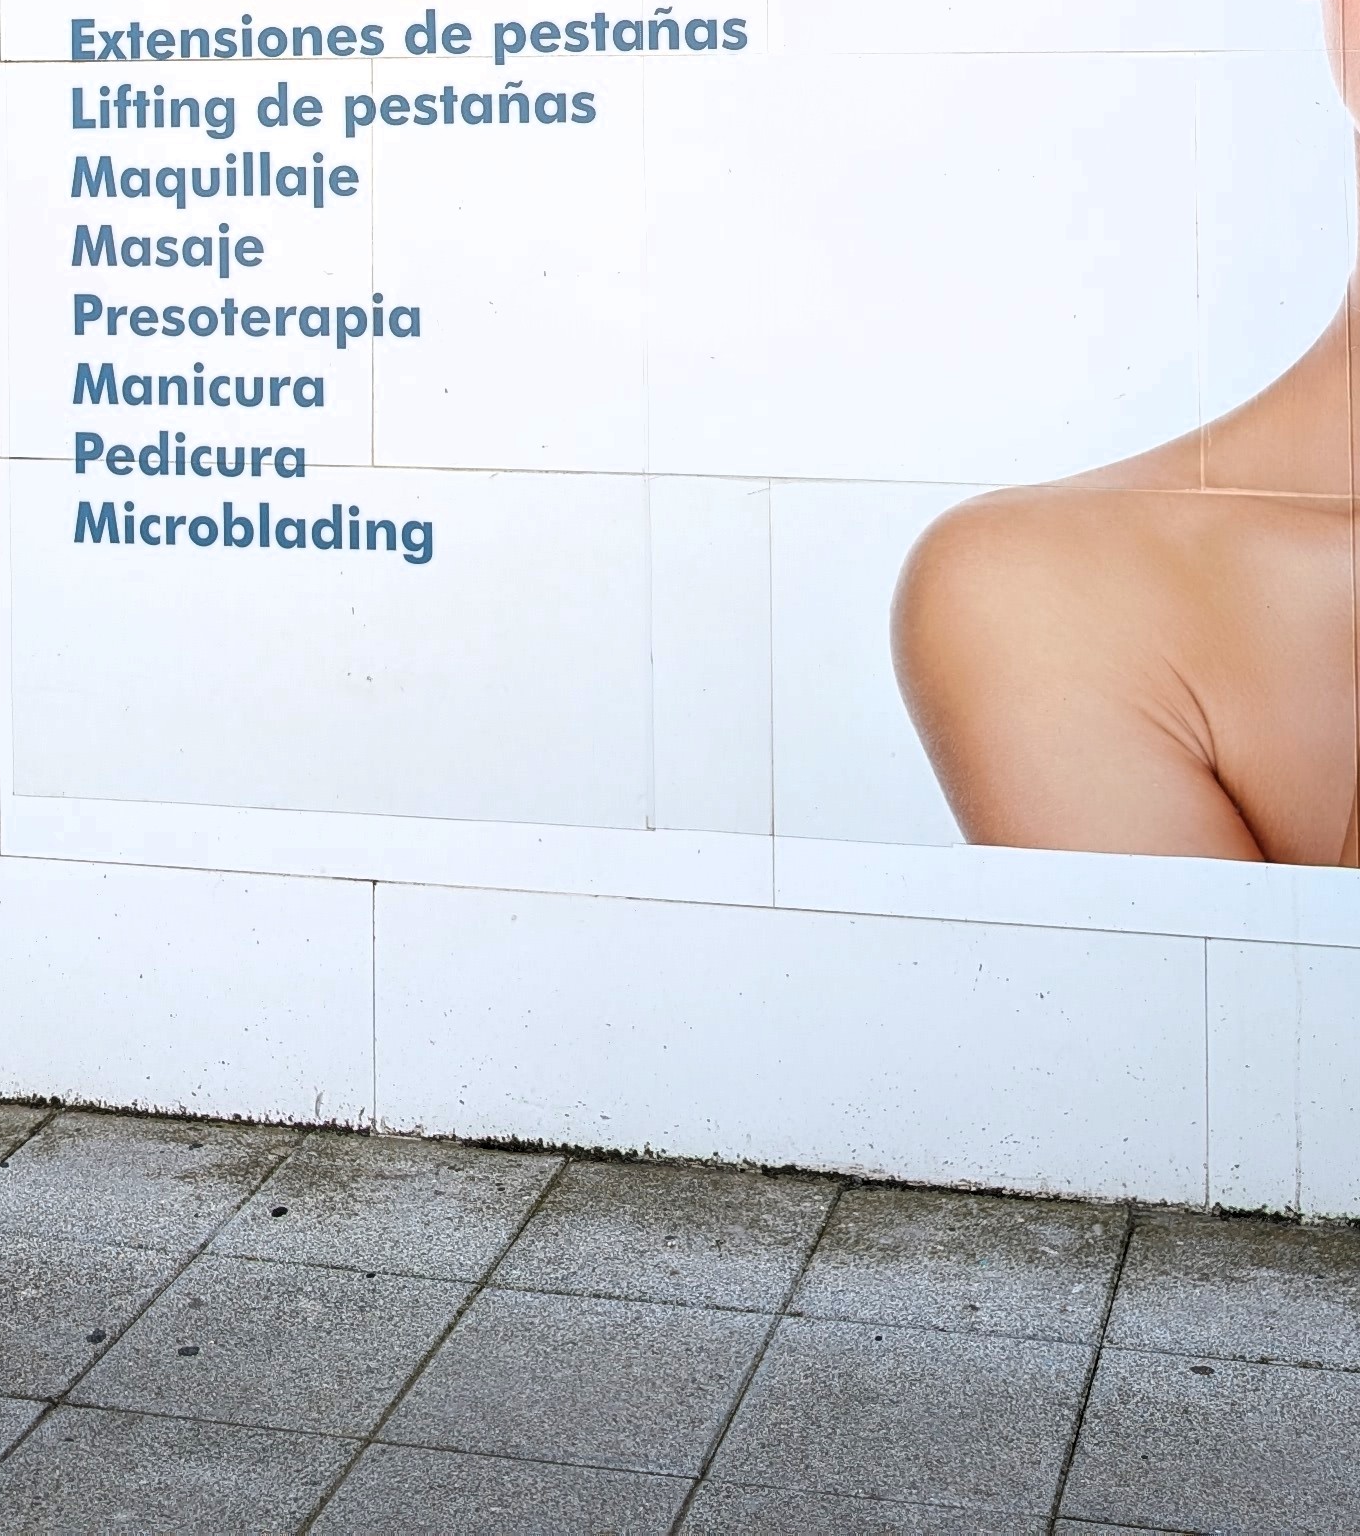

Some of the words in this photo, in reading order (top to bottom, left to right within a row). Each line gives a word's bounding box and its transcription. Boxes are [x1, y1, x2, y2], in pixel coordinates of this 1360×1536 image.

[70, 14, 385, 61] Extensiones
[404, 9, 472, 55] de
[494, 7, 748, 66] pestañas
[71, 83, 236, 140] Lifting
[257, 81, 323, 128] de
[345, 81, 597, 138] pestañas
[71, 151, 359, 209] Maquillaje
[71, 222, 265, 279] Masaje
[73, 292, 421, 350] Presoterapia
[72, 362, 325, 408] Manicura
[74, 430, 306, 479] Pedicura
[73, 500, 434, 565] Microblading
